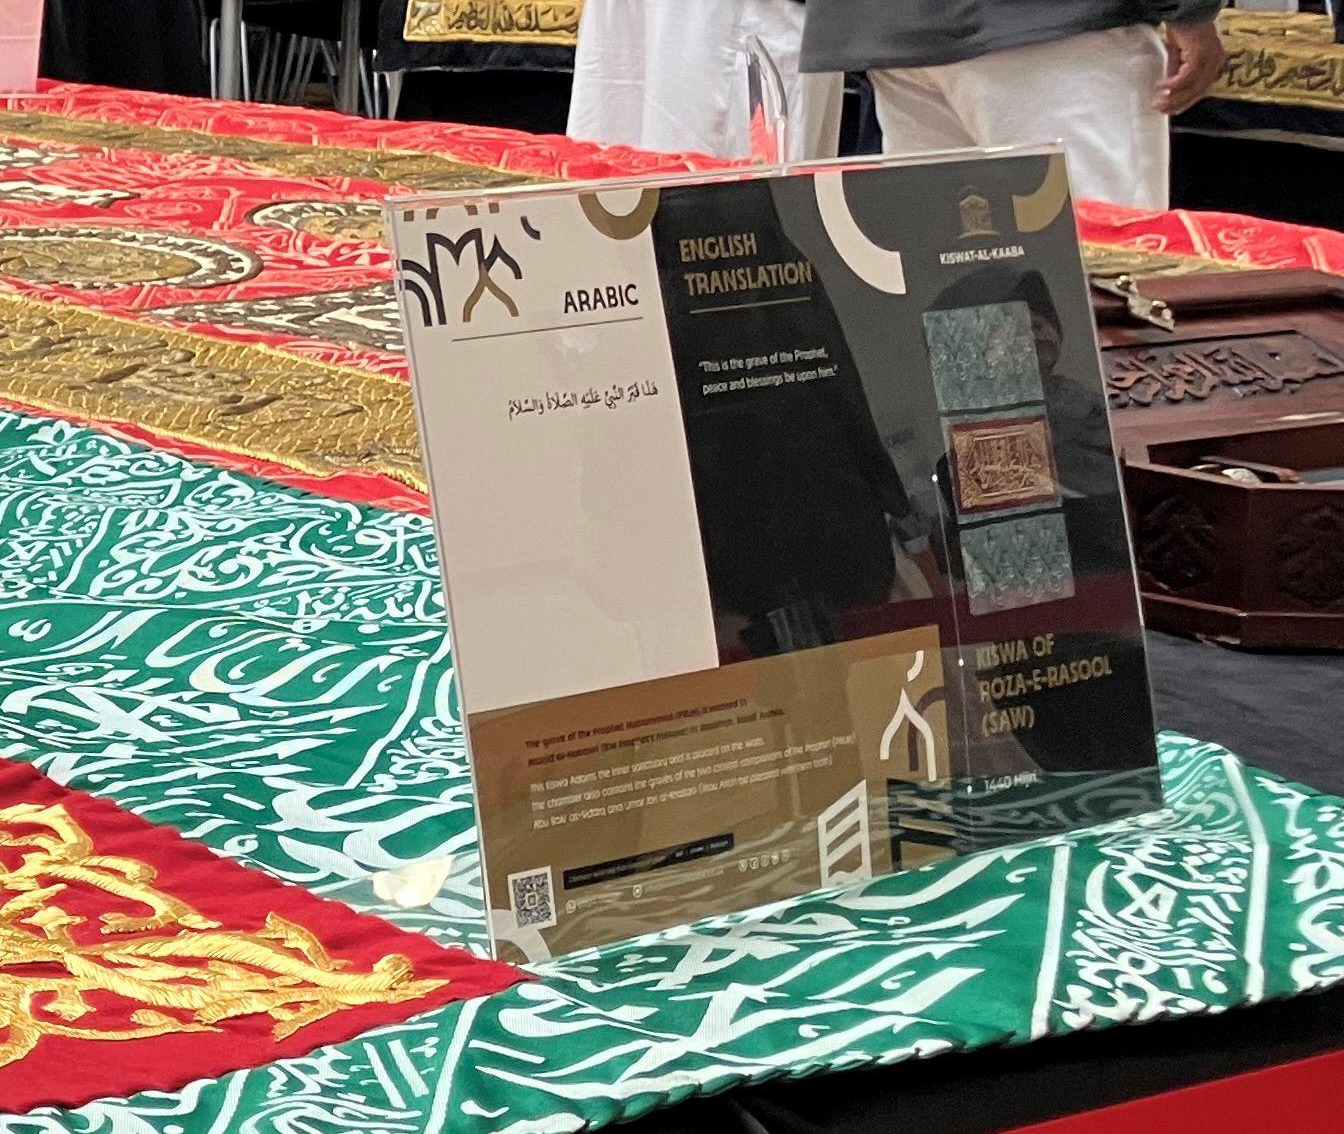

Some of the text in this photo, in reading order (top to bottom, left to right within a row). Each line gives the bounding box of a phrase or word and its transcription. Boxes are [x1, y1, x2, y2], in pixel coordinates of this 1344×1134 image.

[679, 233, 757, 262] ENGLISH
[939, 245, 1025, 265] KISWAT-AL-KAABA
[684, 260, 814, 297] TRANSLATION
[563, 284, 640, 315] ARABIC
[730, 358, 744, 370] the
[745, 356, 768, 370] grave
[770, 352, 778, 363] of
[779, 351, 794, 363] the
[703, 382, 728, 396] peace
[729, 378, 746, 391] and
[746, 374, 783, 388] blessings
[784, 372, 795, 383] be
[796, 370, 817, 383] upon
[976, 632, 1055, 671] KISWA OF
[979, 654, 1113, 703] ROZA-E-RASOOL
[981, 704, 1036, 738] (SAW)
[568, 731, 577, 741] of
[597, 768, 611, 779] the
[984, 775, 1012, 794] 1440
[533, 817, 550, 830] Abu
